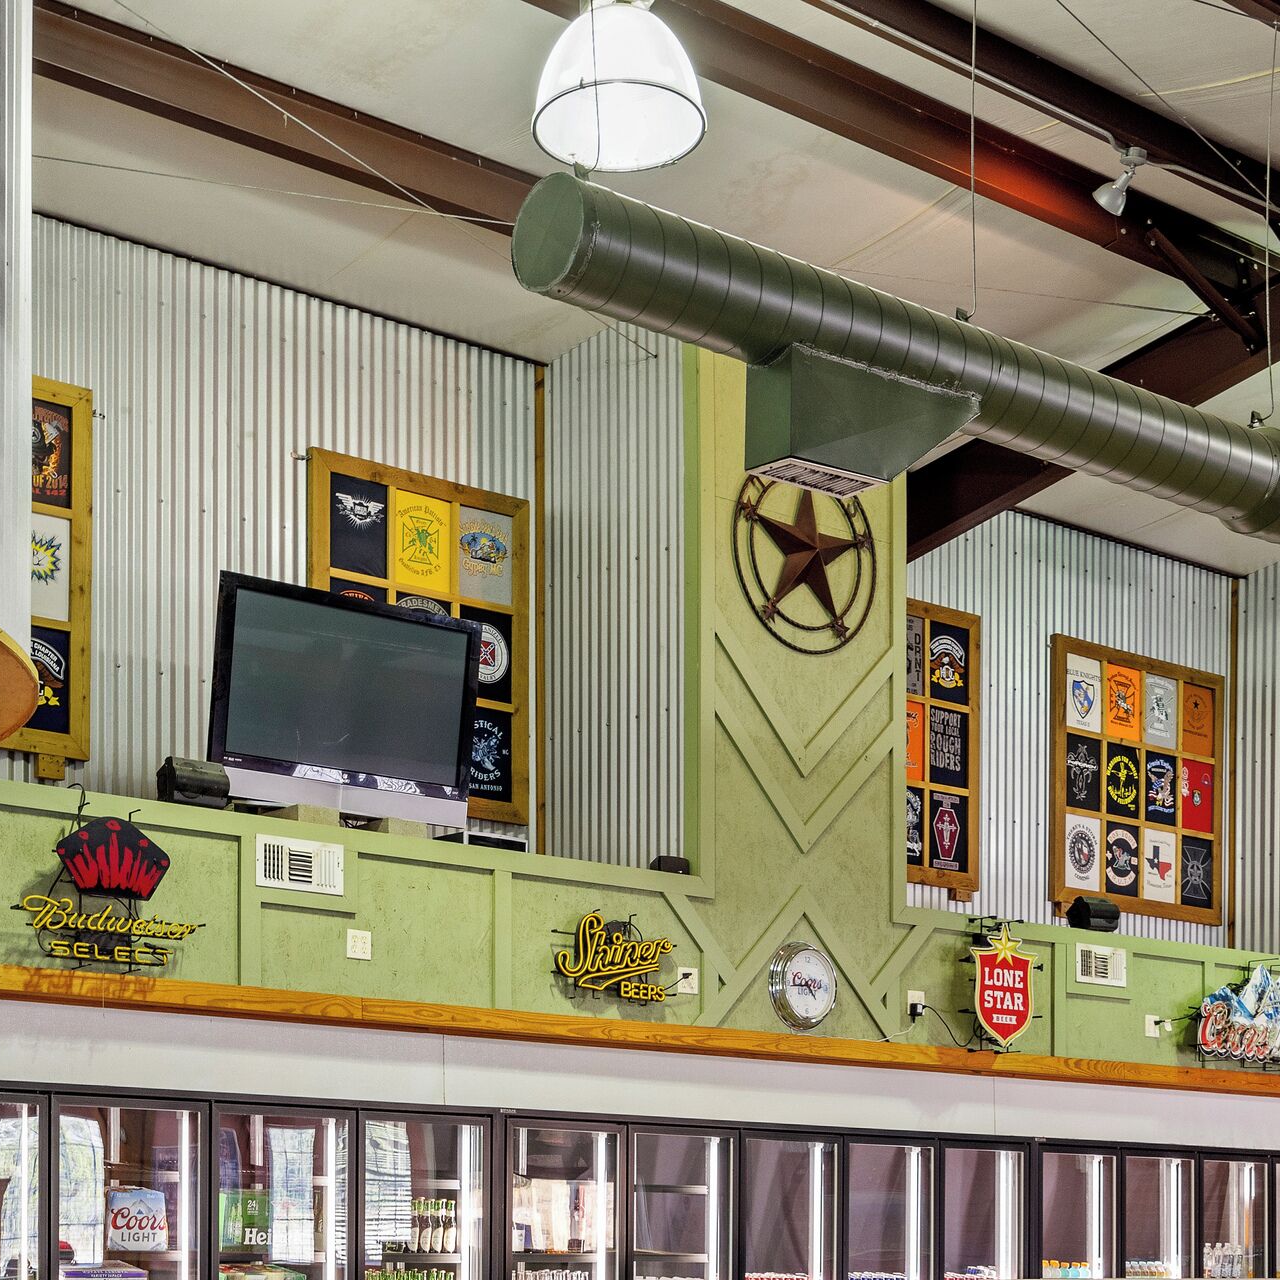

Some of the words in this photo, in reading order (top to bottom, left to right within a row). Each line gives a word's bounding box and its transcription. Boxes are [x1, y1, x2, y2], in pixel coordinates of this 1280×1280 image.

[34, 642, 58, 662] CHAPTER
[35, 650, 60, 673] LOUISIANA
[1080, 670, 1102, 682] KNIGHTS
[930, 708, 961, 728] SUPPORT
[931, 721, 944, 732] YOUR
[945, 725, 960, 737] LOCAL
[930, 733, 961, 756] ROUGH
[930, 751, 961, 772] RIDERS
[470, 766, 501, 781] RIDERS
[480, 783, 503, 792] ANTONIO
[23, 895, 197, 938] Budweiser
[50, 940, 173, 966] SELECT
[558, 913, 673, 977] Shiner
[792, 972, 822, 990] Coors
[984, 967, 1023, 988] LONE
[620, 981, 666, 1001] BEERS
[984, 990, 1024, 1011] STAR
[1198, 1001, 1270, 1062] Coors
[247, 1200, 256, 1208] 24
[111, 1207, 167, 1230] Coors
[121, 1232, 157, 1242] LIGHT
